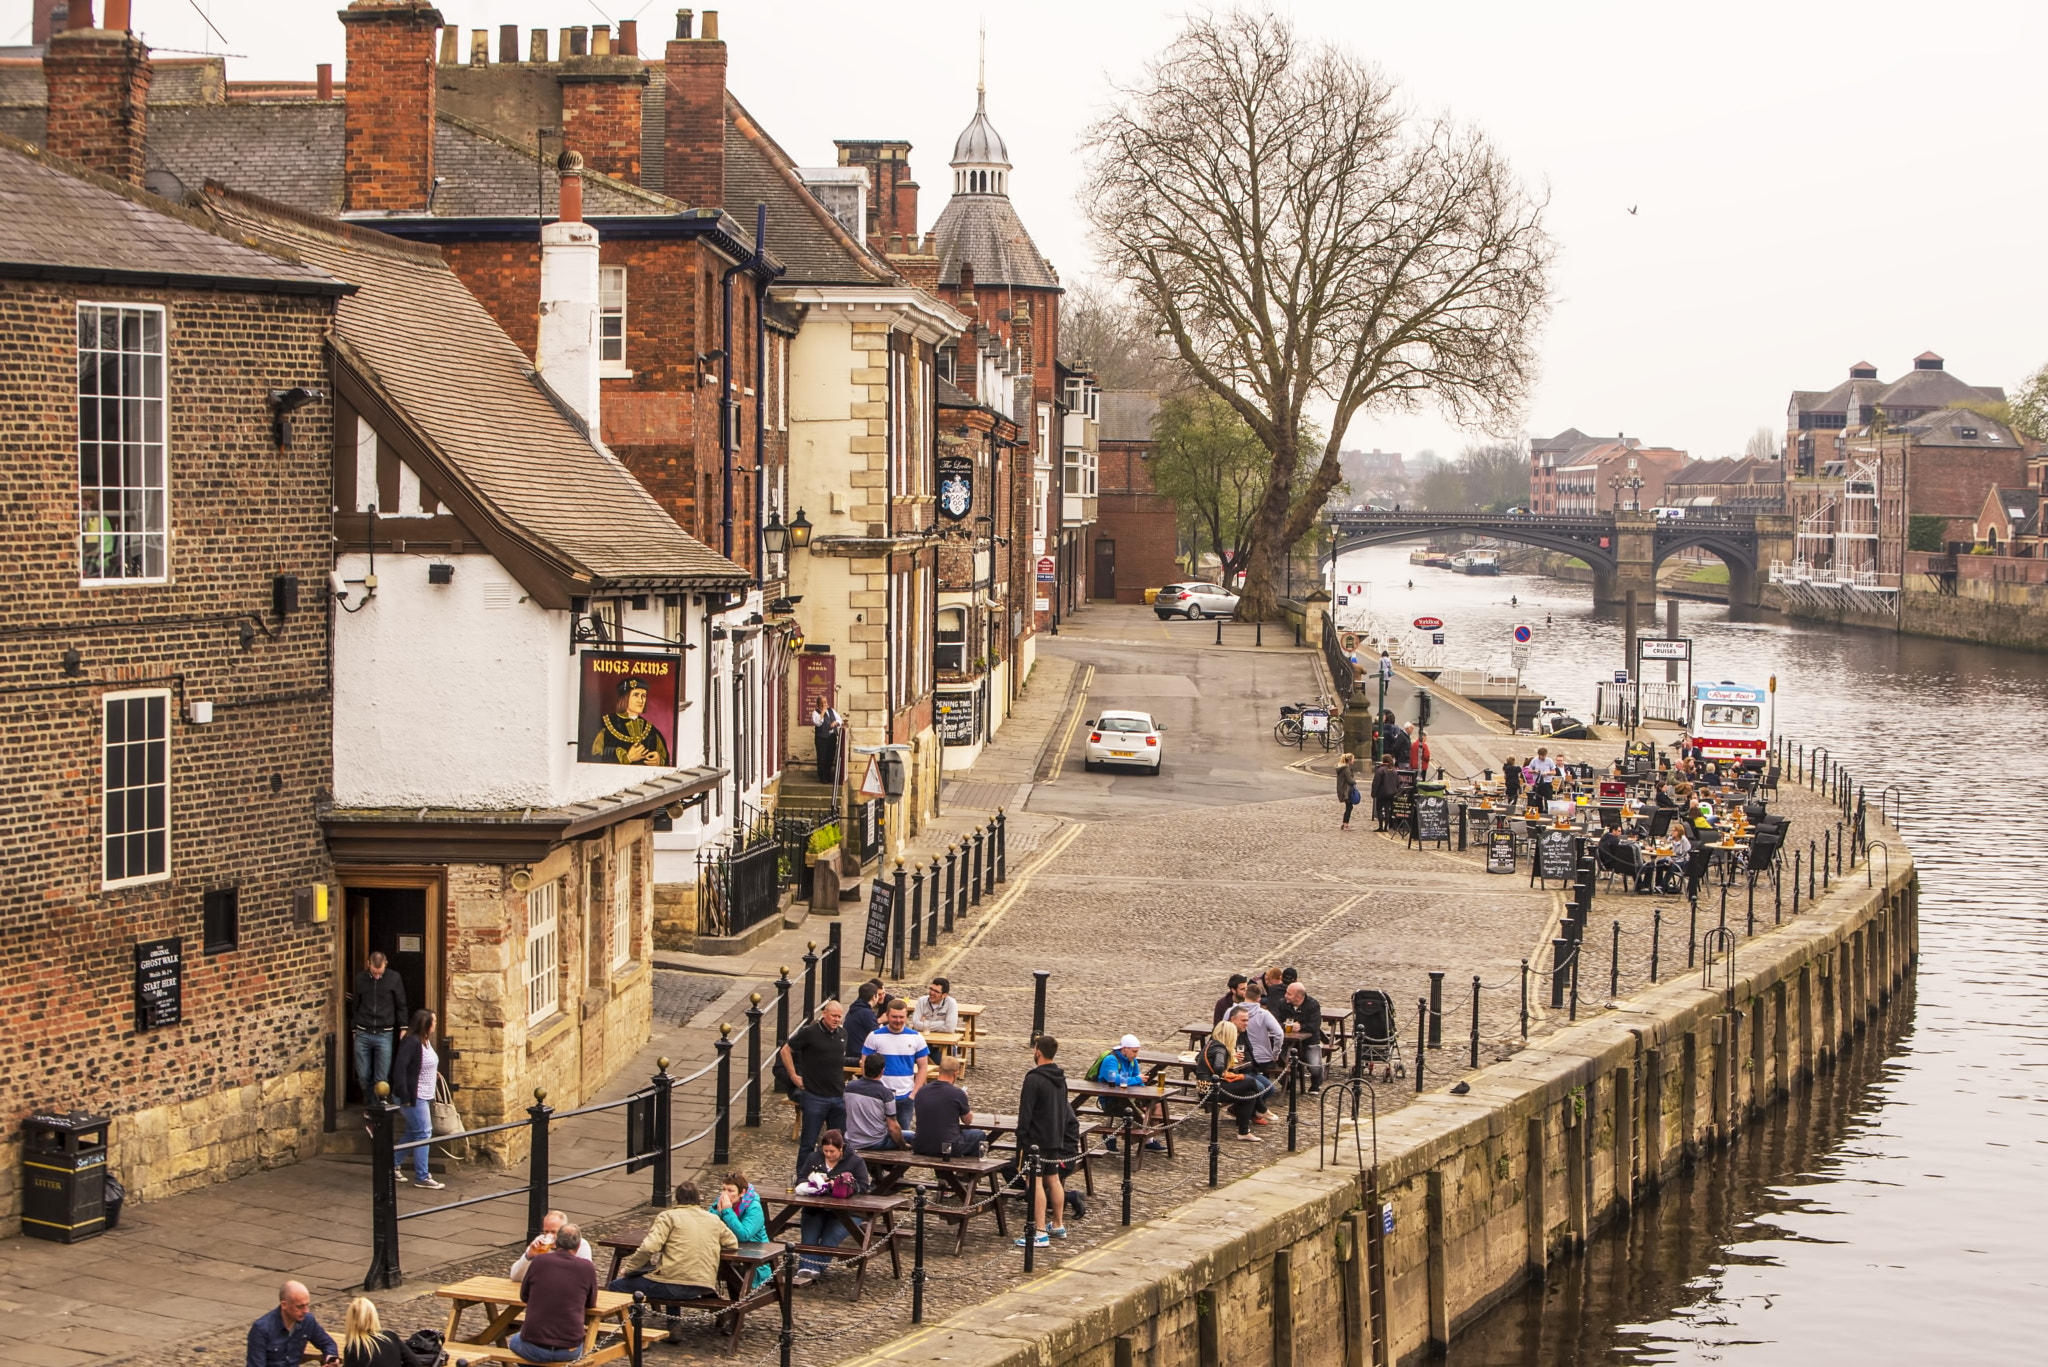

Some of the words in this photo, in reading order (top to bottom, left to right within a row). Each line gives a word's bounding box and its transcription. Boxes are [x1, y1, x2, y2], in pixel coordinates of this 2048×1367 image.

[593, 660, 630, 675] KINGS
[631, 661, 669, 676] ARMS
[141, 958, 161, 970] GHOST
[162, 955, 179, 965] WALK
[143, 980, 160, 992] START
[161, 977, 177, 988] HERE
[35, 1178, 62, 1190] LITTER
